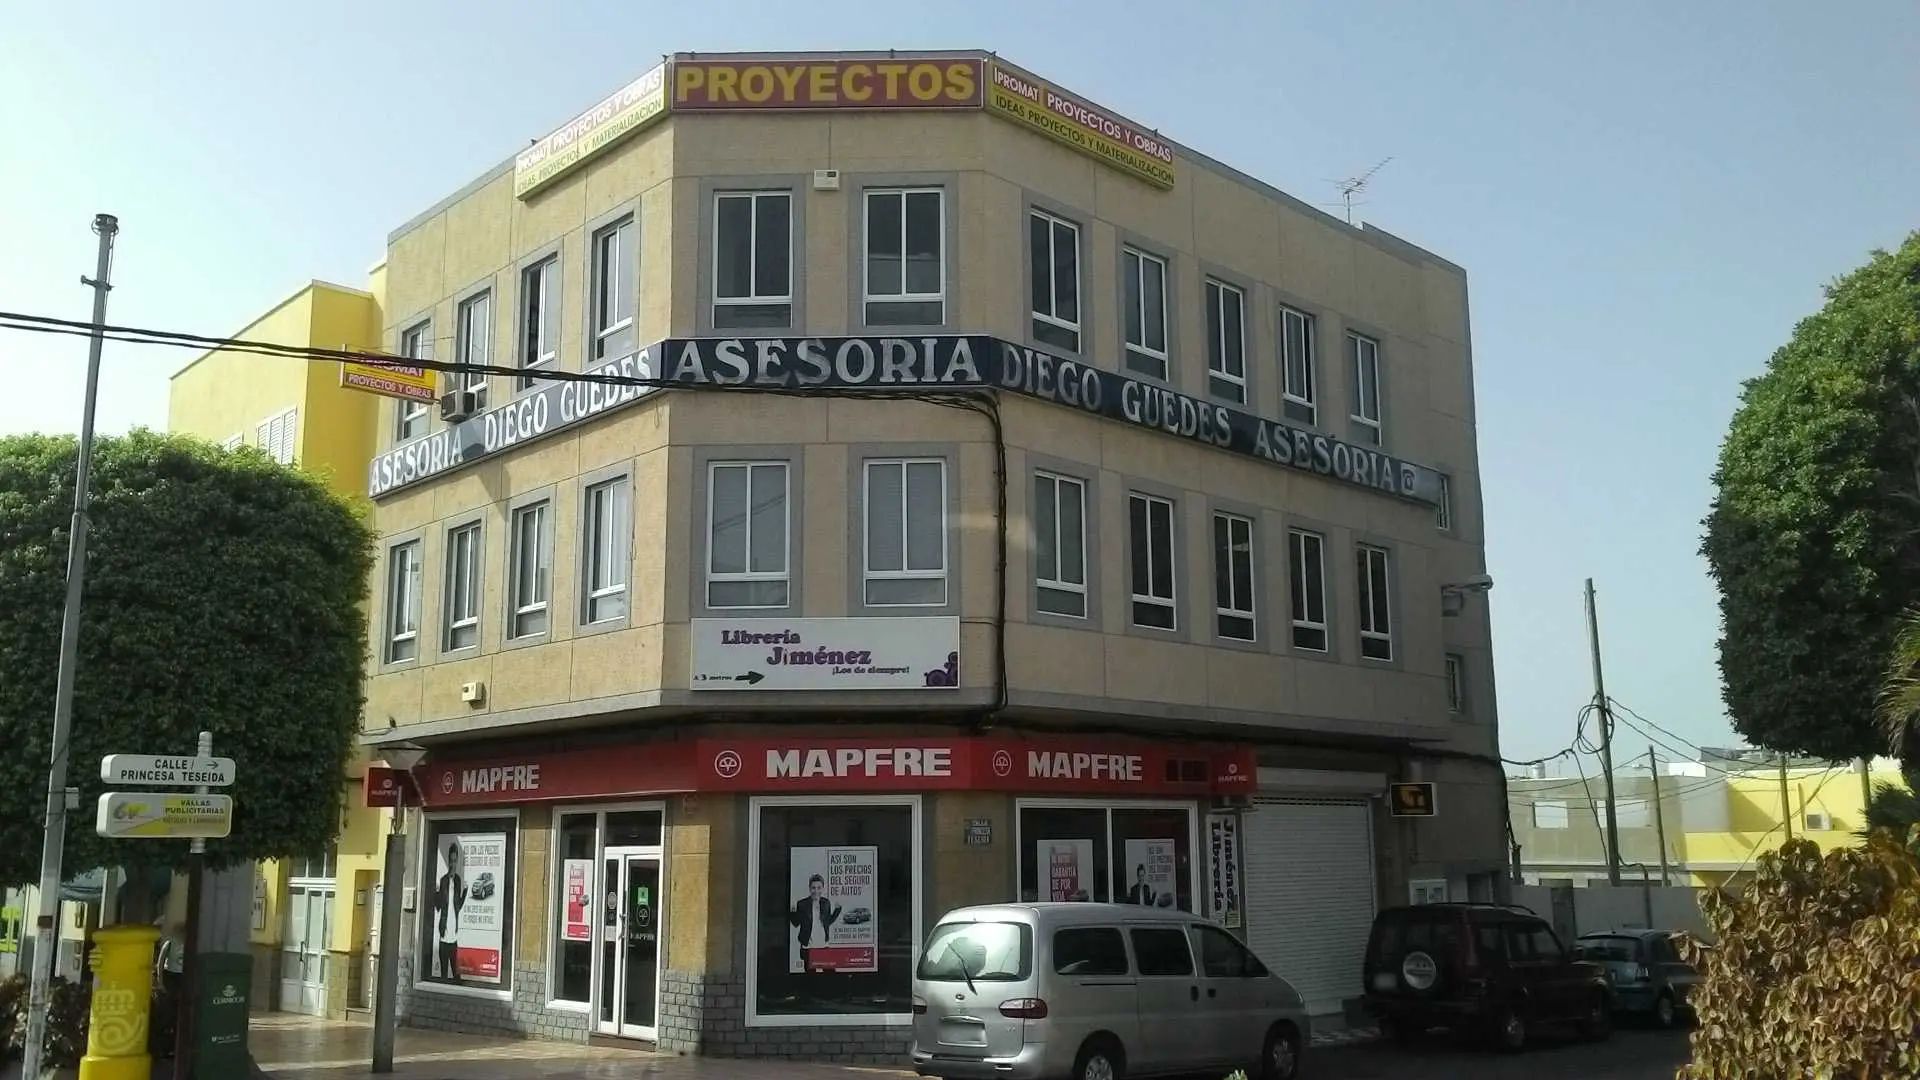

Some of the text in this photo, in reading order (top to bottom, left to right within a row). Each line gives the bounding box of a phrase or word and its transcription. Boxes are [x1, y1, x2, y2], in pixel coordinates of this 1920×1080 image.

[678, 63, 975, 103] PROYECTOS
[553, 104, 613, 151] PROYECTOS
[615, 96, 623, 112] Y
[994, 67, 1172, 162] IPROMAT PROYECTOS Y OBRAS
[996, 95, 1025, 117] IDEAS
[1028, 110, 1086, 144] PROYECTOS
[1088, 137, 1095, 148] Y
[583, 143, 590, 153] Y
[672, 337, 982, 385] ASESORIA
[348, 374, 397, 393] PROYECTOS
[398, 384, 405, 393] Y
[405, 386, 432, 399] OBRAS
[369, 349, 652, 496] ASESORIA DIEGO GUEDES
[1001, 343, 1396, 492] DIEGO GUEDES ASESORIA
[721, 629, 801, 645] Librería
[766, 645, 873, 666] Jiménez
[700, 673, 708, 681] 3
[154, 759, 188, 770] CALLE
[765, 747, 952, 778] MAPFRE
[1027, 750, 1143, 782] MAPFRE
[120, 769, 225, 783] PRINCESA TESEIDA
[461, 763, 541, 794] MAPFRE
[165, 807, 225, 815] PUBLICITARIAS
[830, 864, 872, 875] LOS PRECIOS
[843, 854, 857, 864] SON
[830, 875, 870, 886] DEL SEGURO
[830, 886, 862, 896] DE AUTOS
